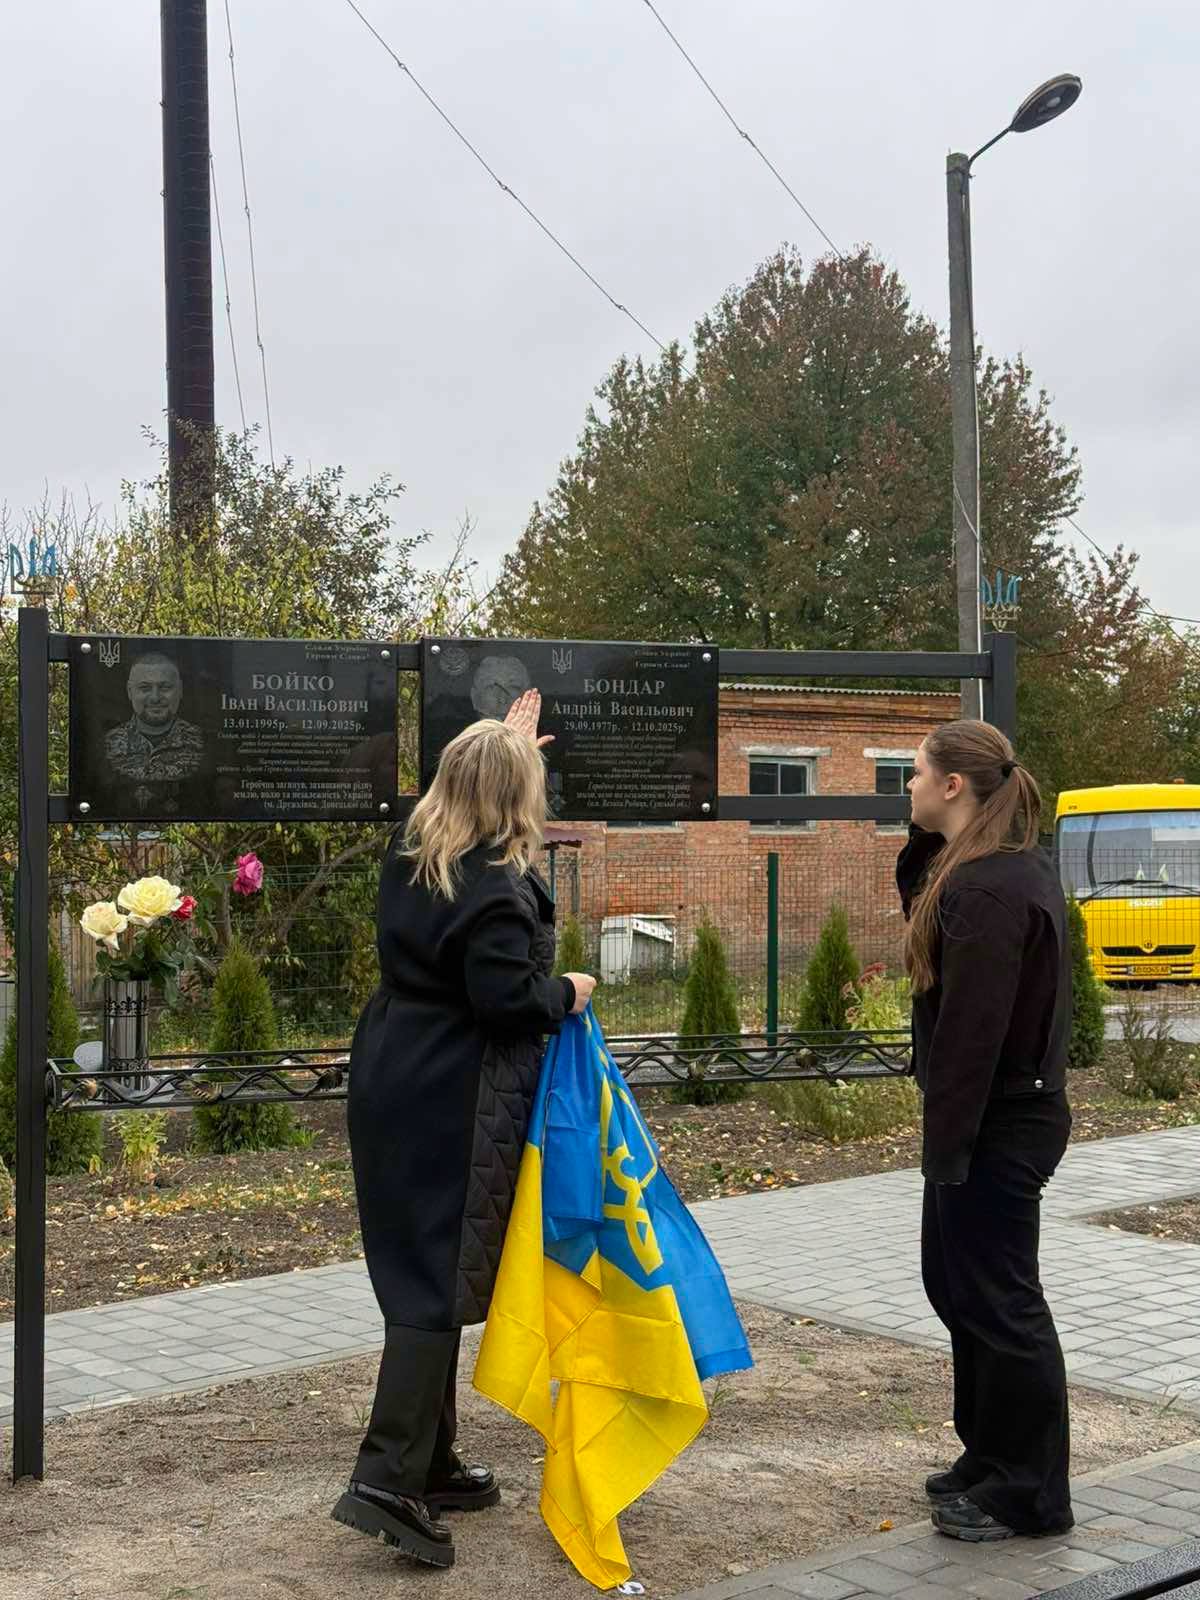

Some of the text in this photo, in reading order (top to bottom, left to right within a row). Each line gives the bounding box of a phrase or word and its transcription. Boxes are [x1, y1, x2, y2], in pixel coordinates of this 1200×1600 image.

[251, 671, 335, 691] БОЙКО
[583, 679, 666, 696] БОНДАР
[551, 701, 694, 718] Андрій Васильович
[223, 718, 288, 731] 13.01.1995р.
[302, 719, 365, 732] 12.09.2025р.
